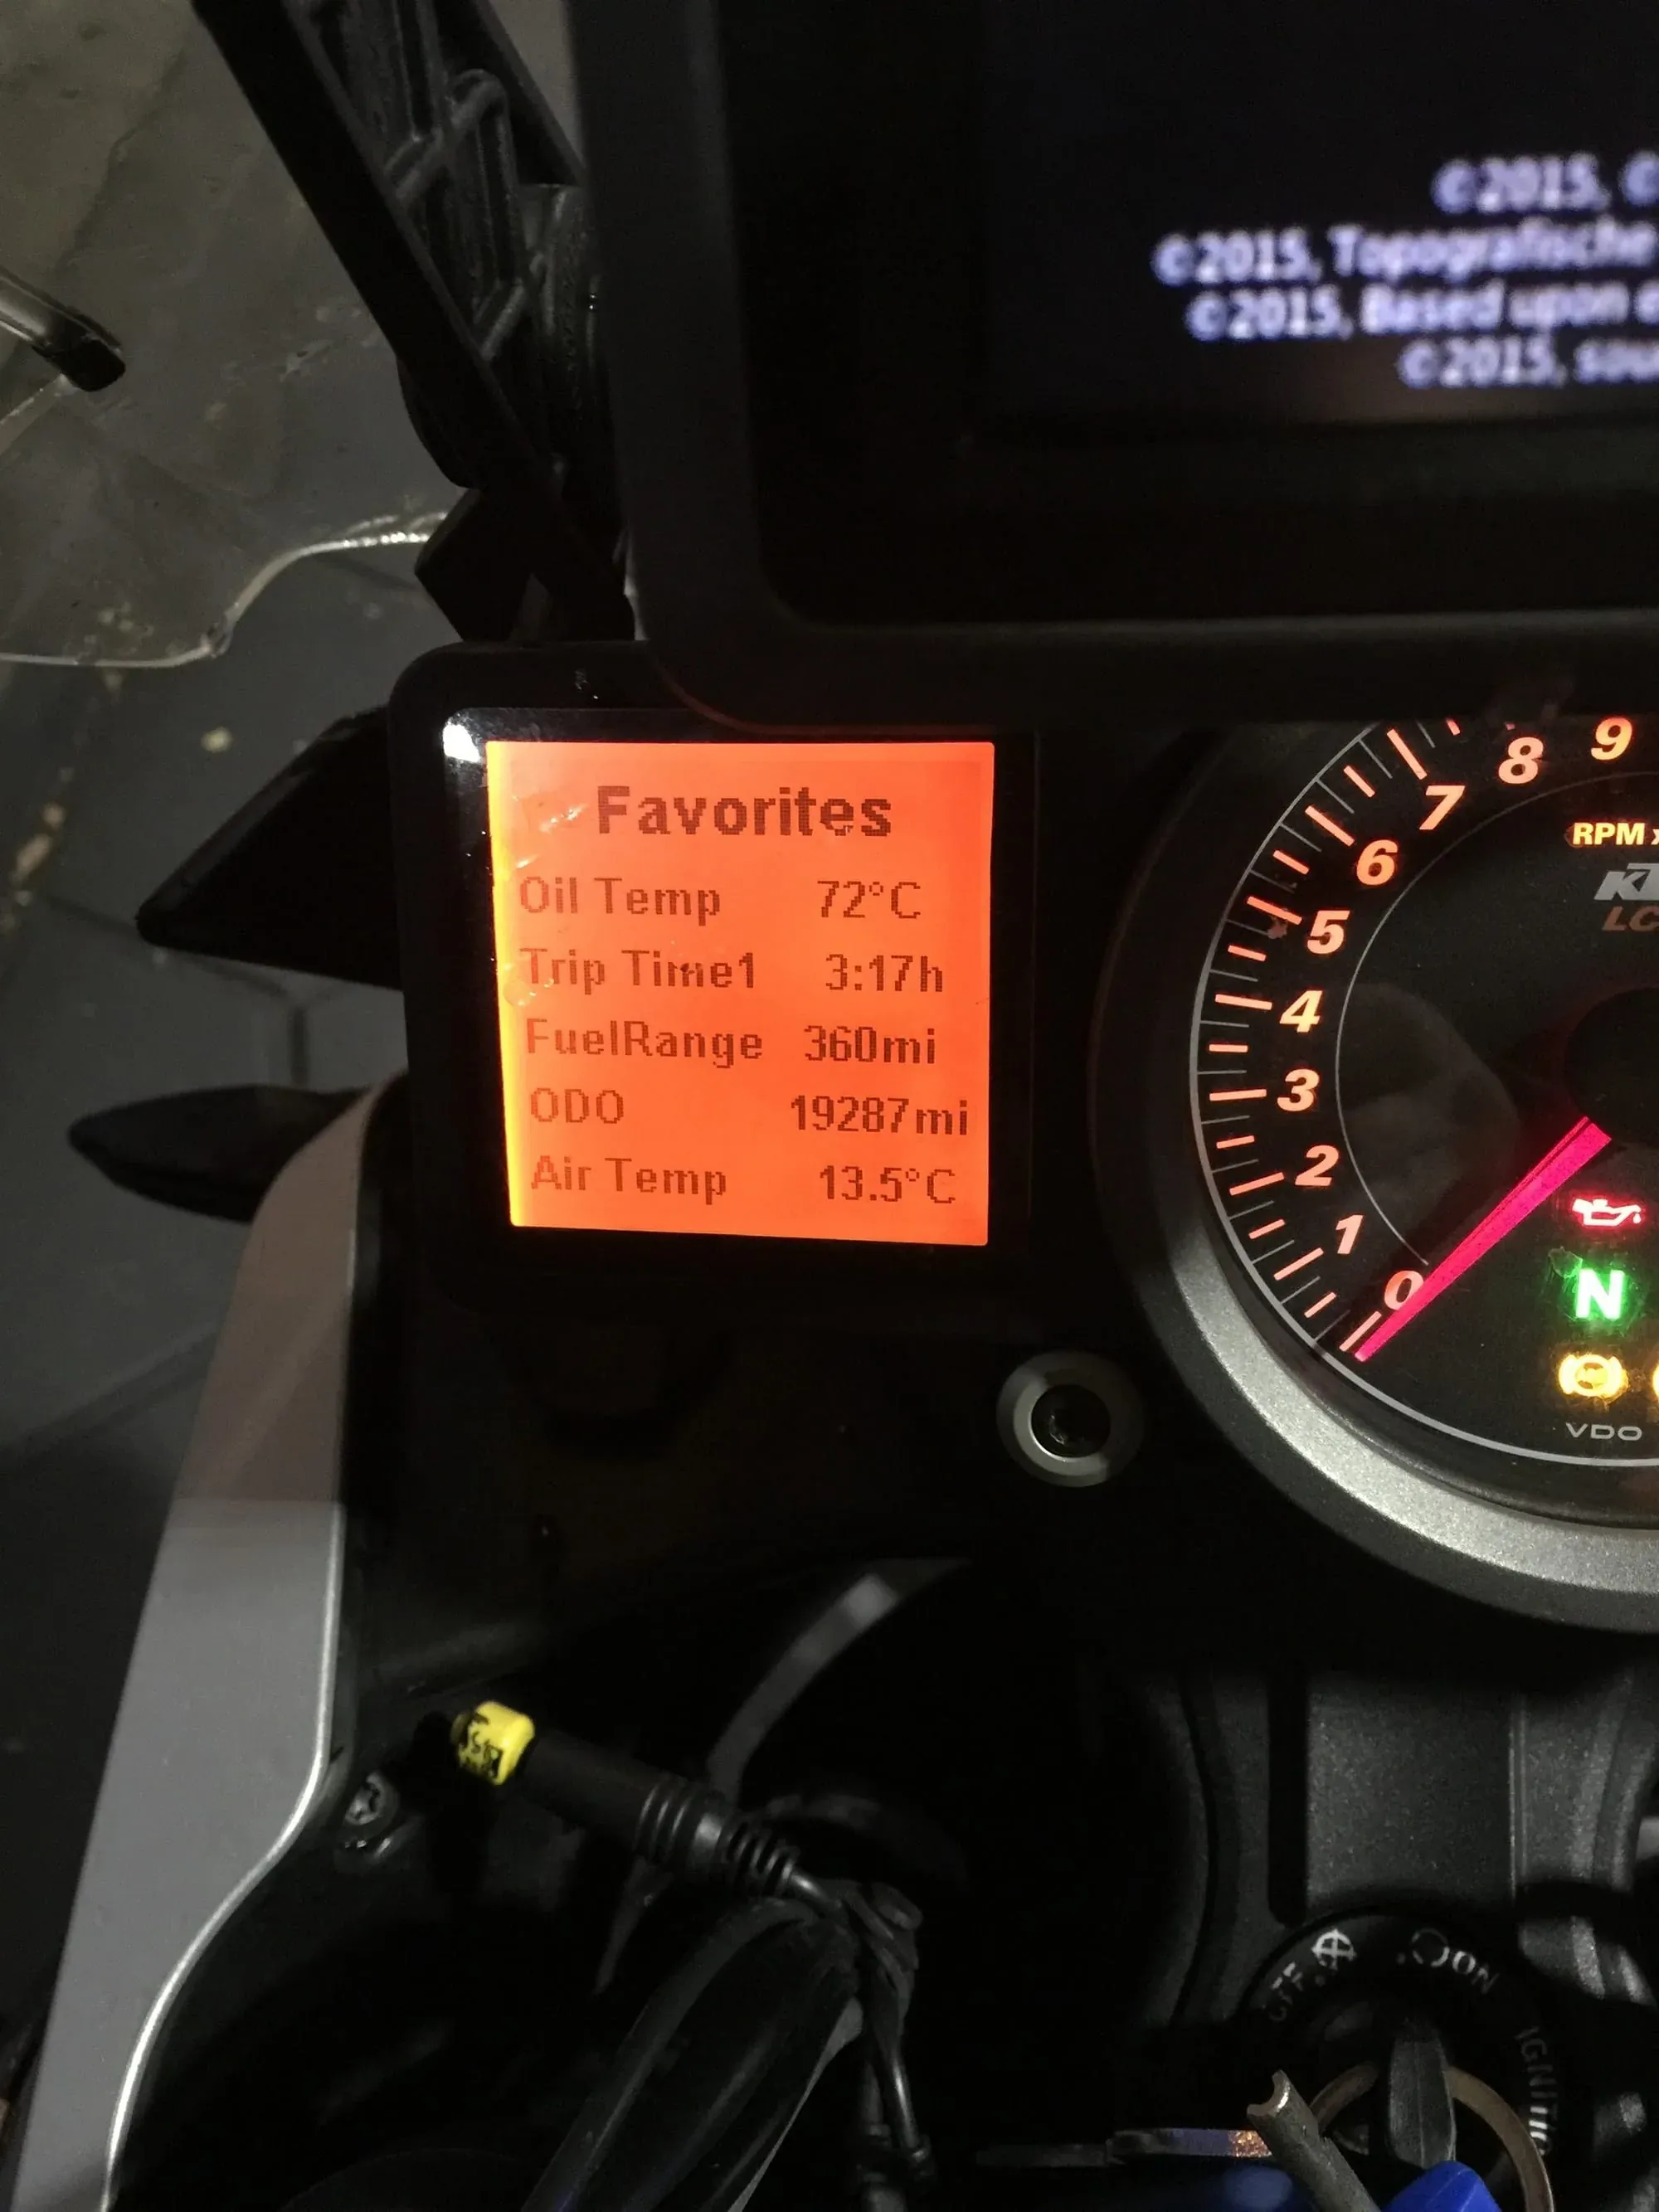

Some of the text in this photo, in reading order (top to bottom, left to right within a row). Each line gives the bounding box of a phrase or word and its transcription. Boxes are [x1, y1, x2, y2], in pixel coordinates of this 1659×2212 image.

[1590, 717, 1633, 761] 9
[1498, 737, 1544, 785] 8
[597, 785, 892, 837] Favorites
[1419, 785, 1465, 830] 7
[1573, 822, 1645, 845] RPM
[1355, 839, 1399, 887] 6
[519, 876, 721, 926] Oil Temp
[817, 880, 921, 920] 72°C
[1306, 910, 1351, 955] 5
[520, 948, 754, 994] Trip Time1
[825, 954, 943, 993] 3:17h
[1279, 989, 1323, 1033] 4
[526, 1018, 763, 1069] FuelRange
[804, 1025, 935, 1064] 360mi
[529, 1087, 625, 1125] ODO
[1277, 1068, 1320, 1111] 3
[791, 1096, 968, 1135] 19287mi
[531, 1155, 727, 1205] Air Temp
[820, 1165, 956, 1203] 13.5°C
[1295, 1145, 1340, 1187] 2
[1335, 1214, 1364, 1255] 1
[1384, 1270, 1424, 1310] 0
[1576, 1269, 1624, 1320] N
[1566, 1422, 1642, 1441] VDO
